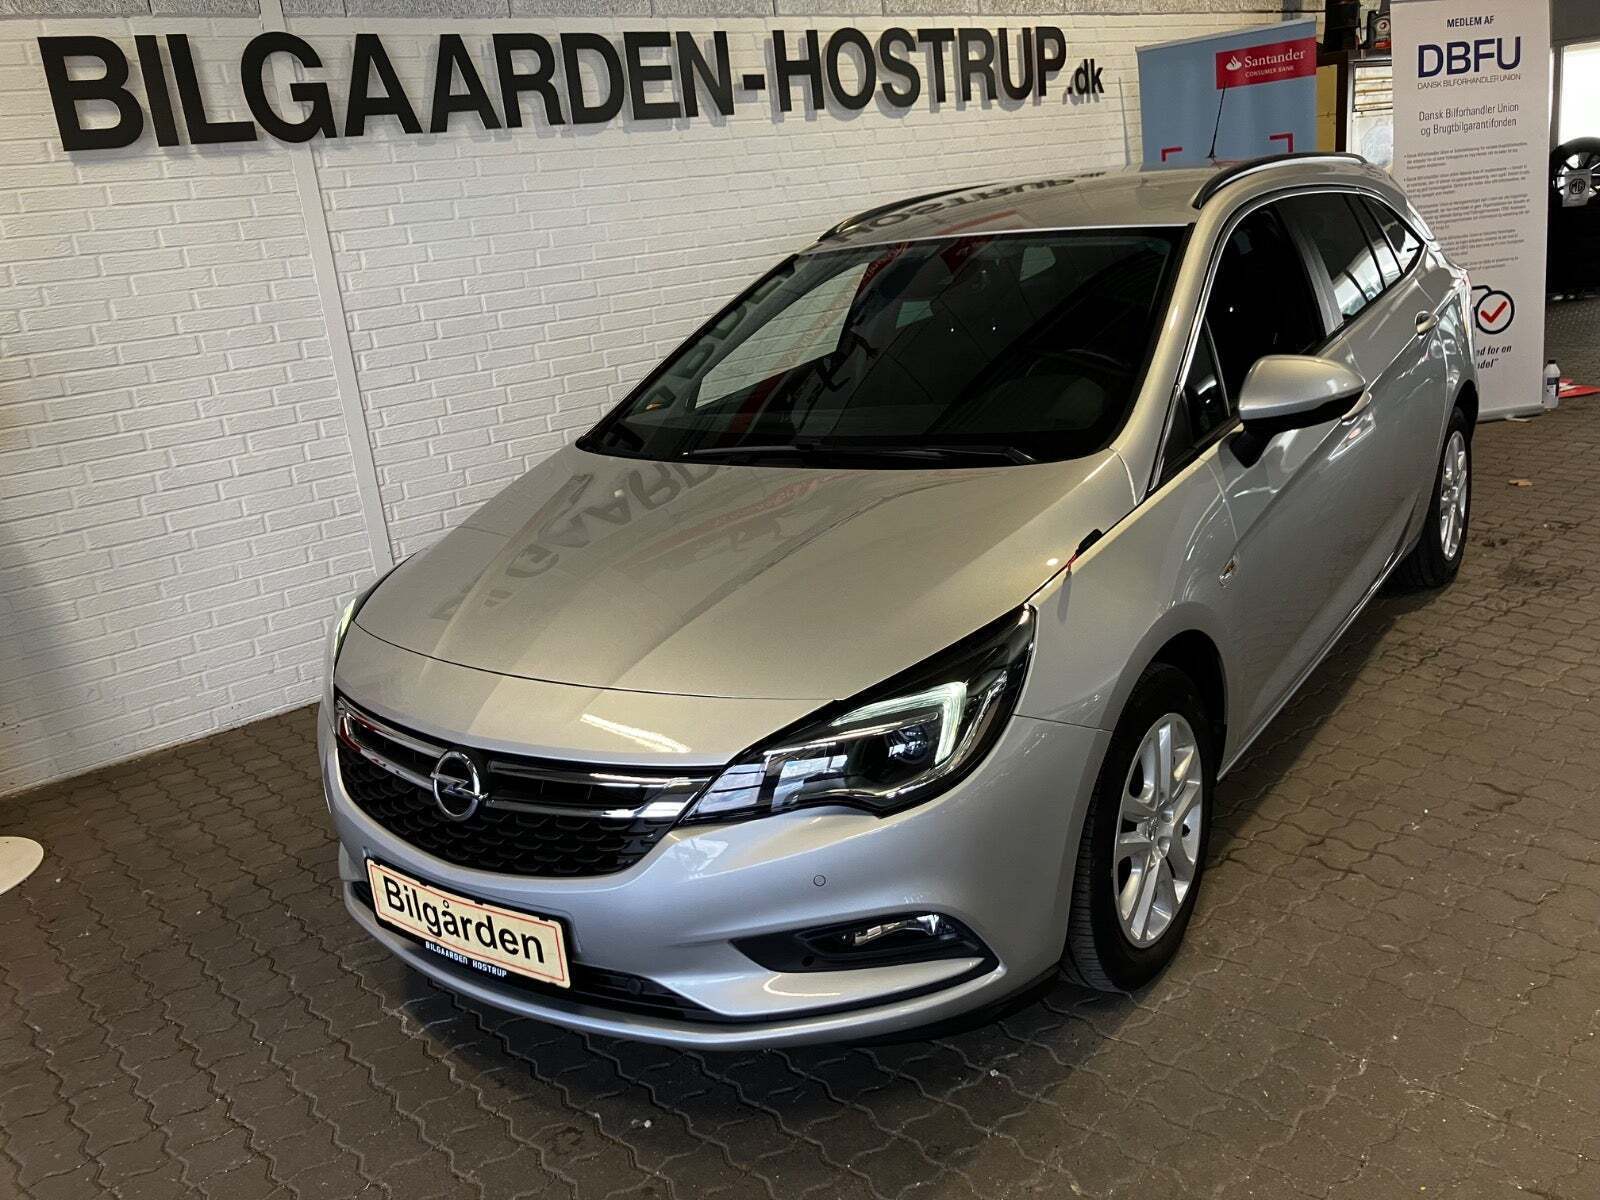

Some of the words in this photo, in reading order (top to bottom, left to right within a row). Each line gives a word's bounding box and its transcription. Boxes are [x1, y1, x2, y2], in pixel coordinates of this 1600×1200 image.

[1446, 16, 1482, 28] MEDLEM
[1483, 15, 1495, 25] AF
[1244, 48, 1306, 68] Santander
[1417, 36, 1521, 79] DBFU
[1245, 67, 1277, 78] CONSUMER
[1278, 65, 1294, 73] BANK
[1417, 81, 1443, 90] DANSK
[1443, 74, 1499, 88] BILFORHANDLER
[1499, 73, 1521, 82] UNION
[1418, 111, 1443, 122] Dansk
[1445, 104, 1496, 119] Bilforhandler
[1497, 103, 1519, 113] Union
[1420, 126, 1431, 137] og
[1433, 118, 1517, 135] Brugtbilgarantifonden
[1487, 345, 1500, 356] for
[382, 875, 545, 964] Bilgården
[425, 941, 468, 966] BILGAARDEN
[472, 959, 507, 978] HOSTRUP
